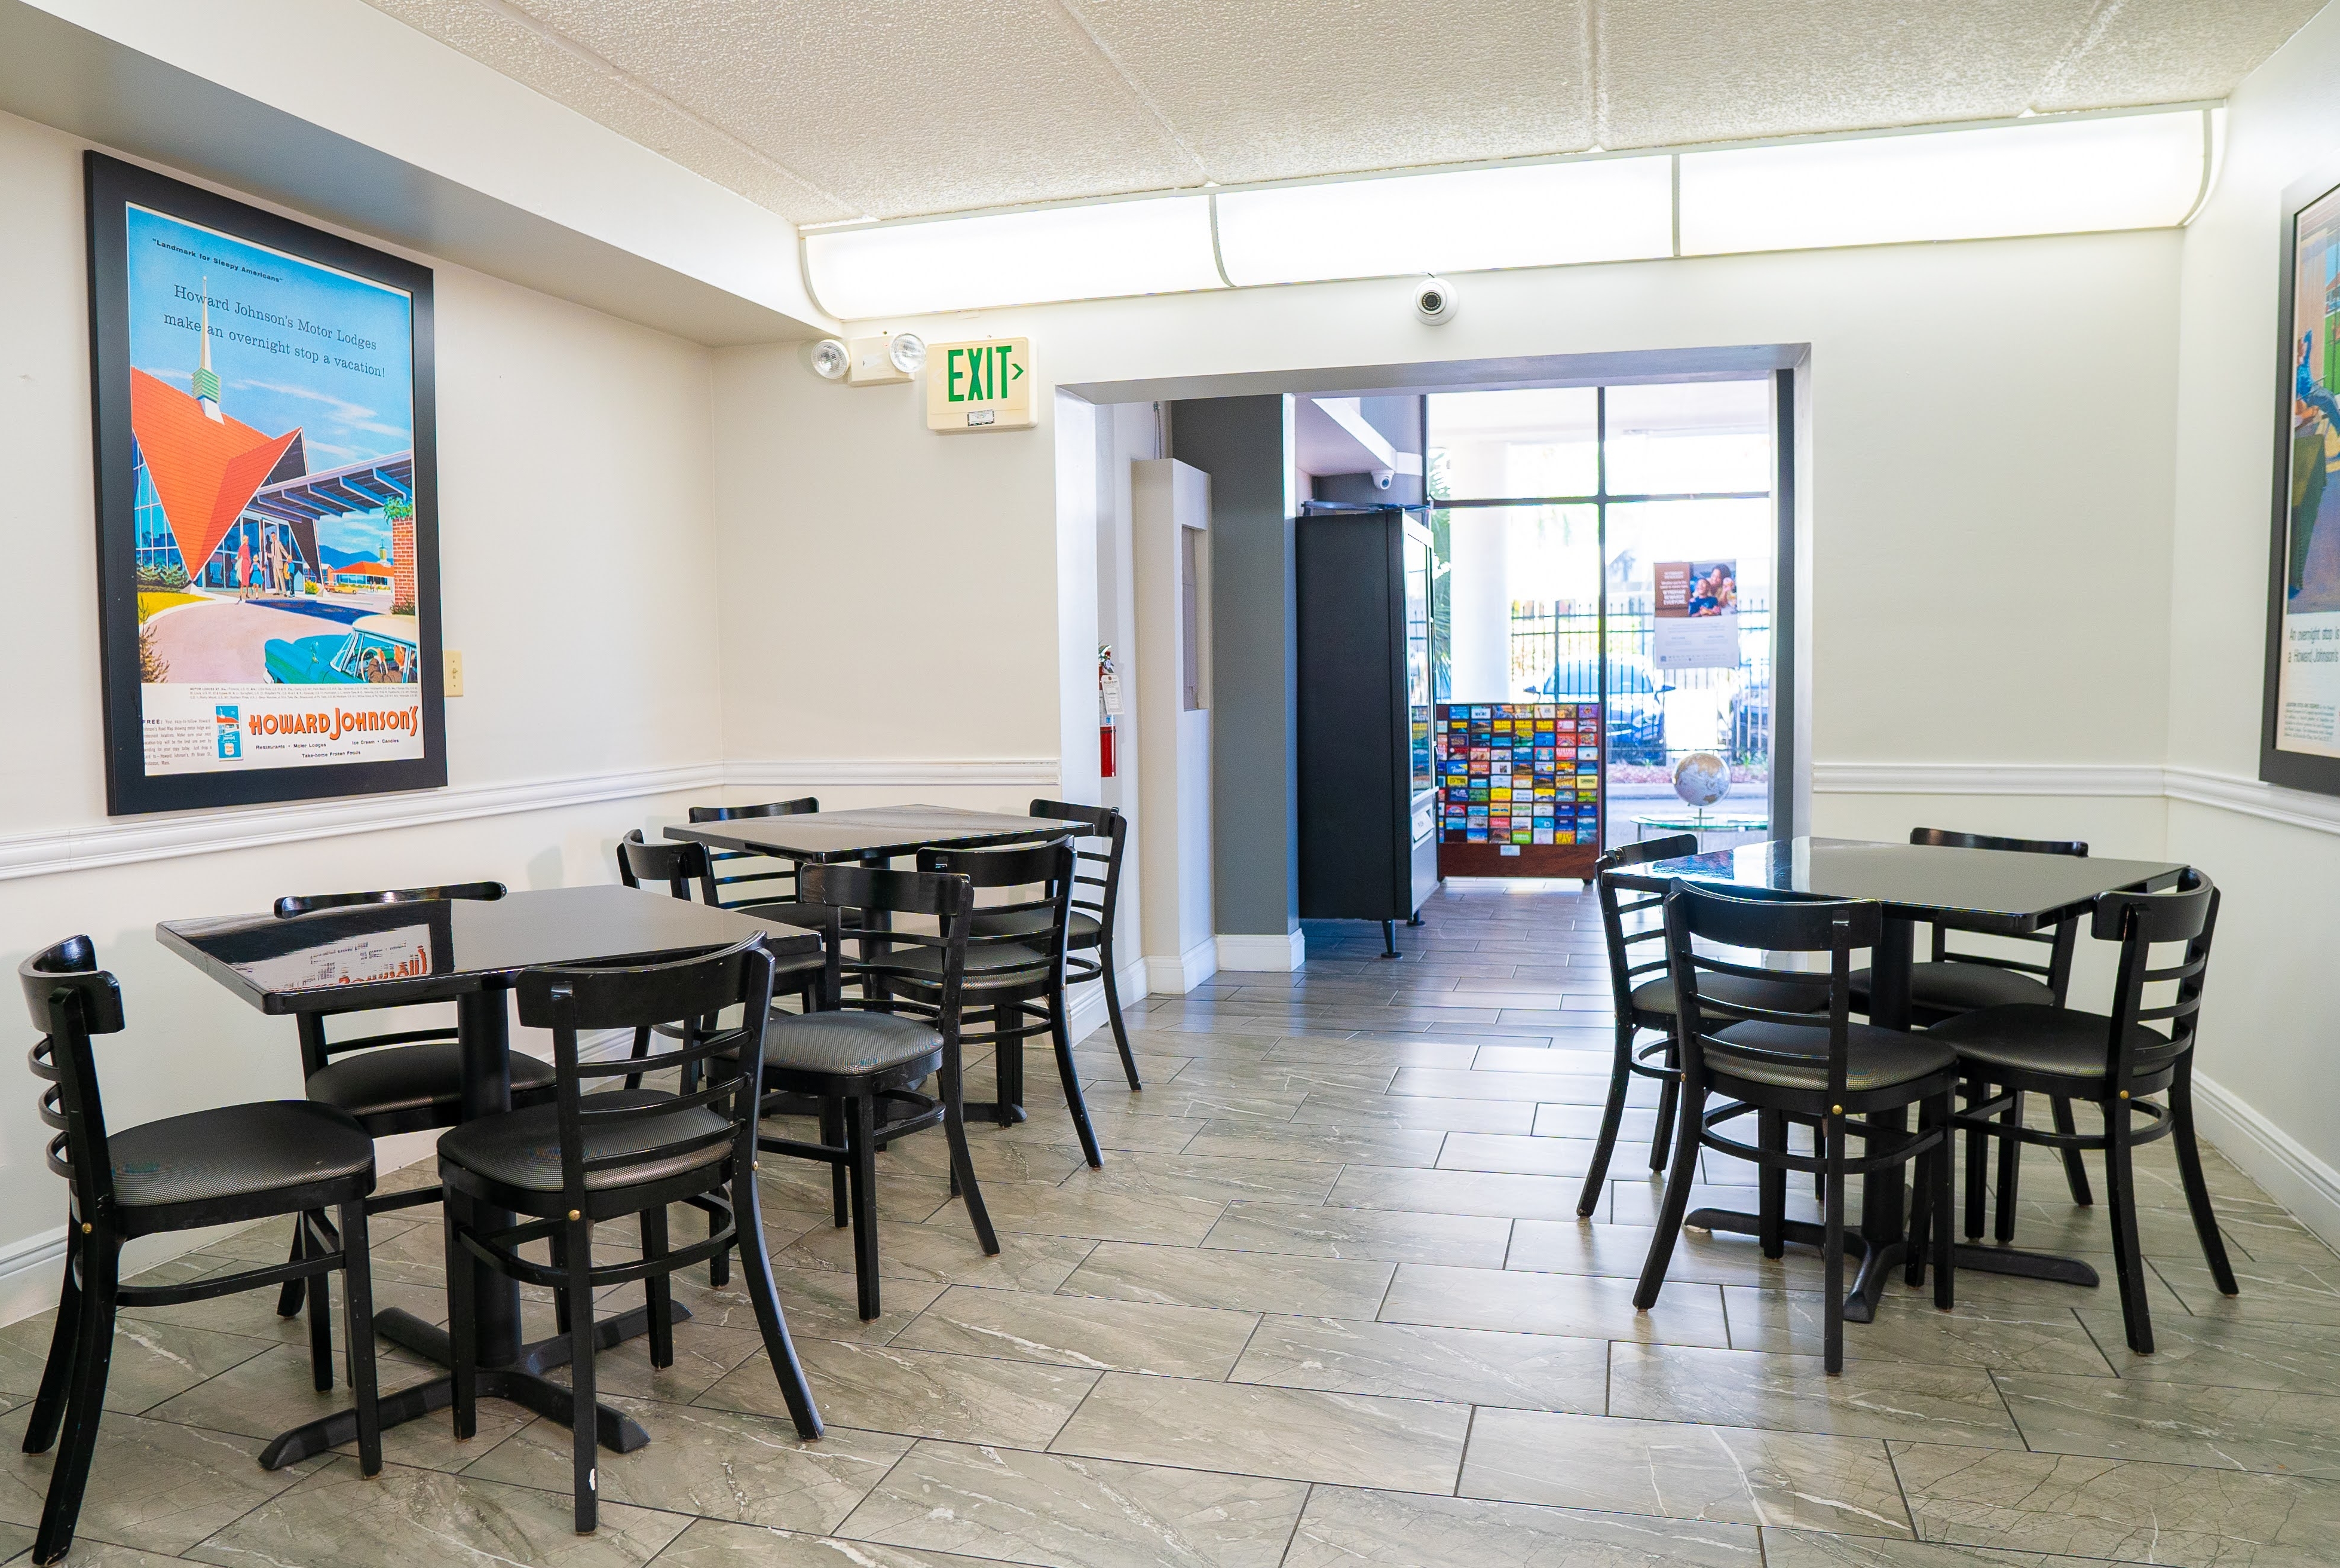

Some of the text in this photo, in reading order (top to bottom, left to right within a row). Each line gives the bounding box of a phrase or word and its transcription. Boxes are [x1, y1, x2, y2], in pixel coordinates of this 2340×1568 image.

[199, 252, 210, 262] for
[213, 258, 238, 272] Sleepy
[163, 313, 385, 378] make an overnight stop a vacation!
[173, 284, 377, 351] Howard Johnson's Motor Lodges
[948, 345, 1012, 402] EXIT
[249, 713, 330, 735] HOWARD
